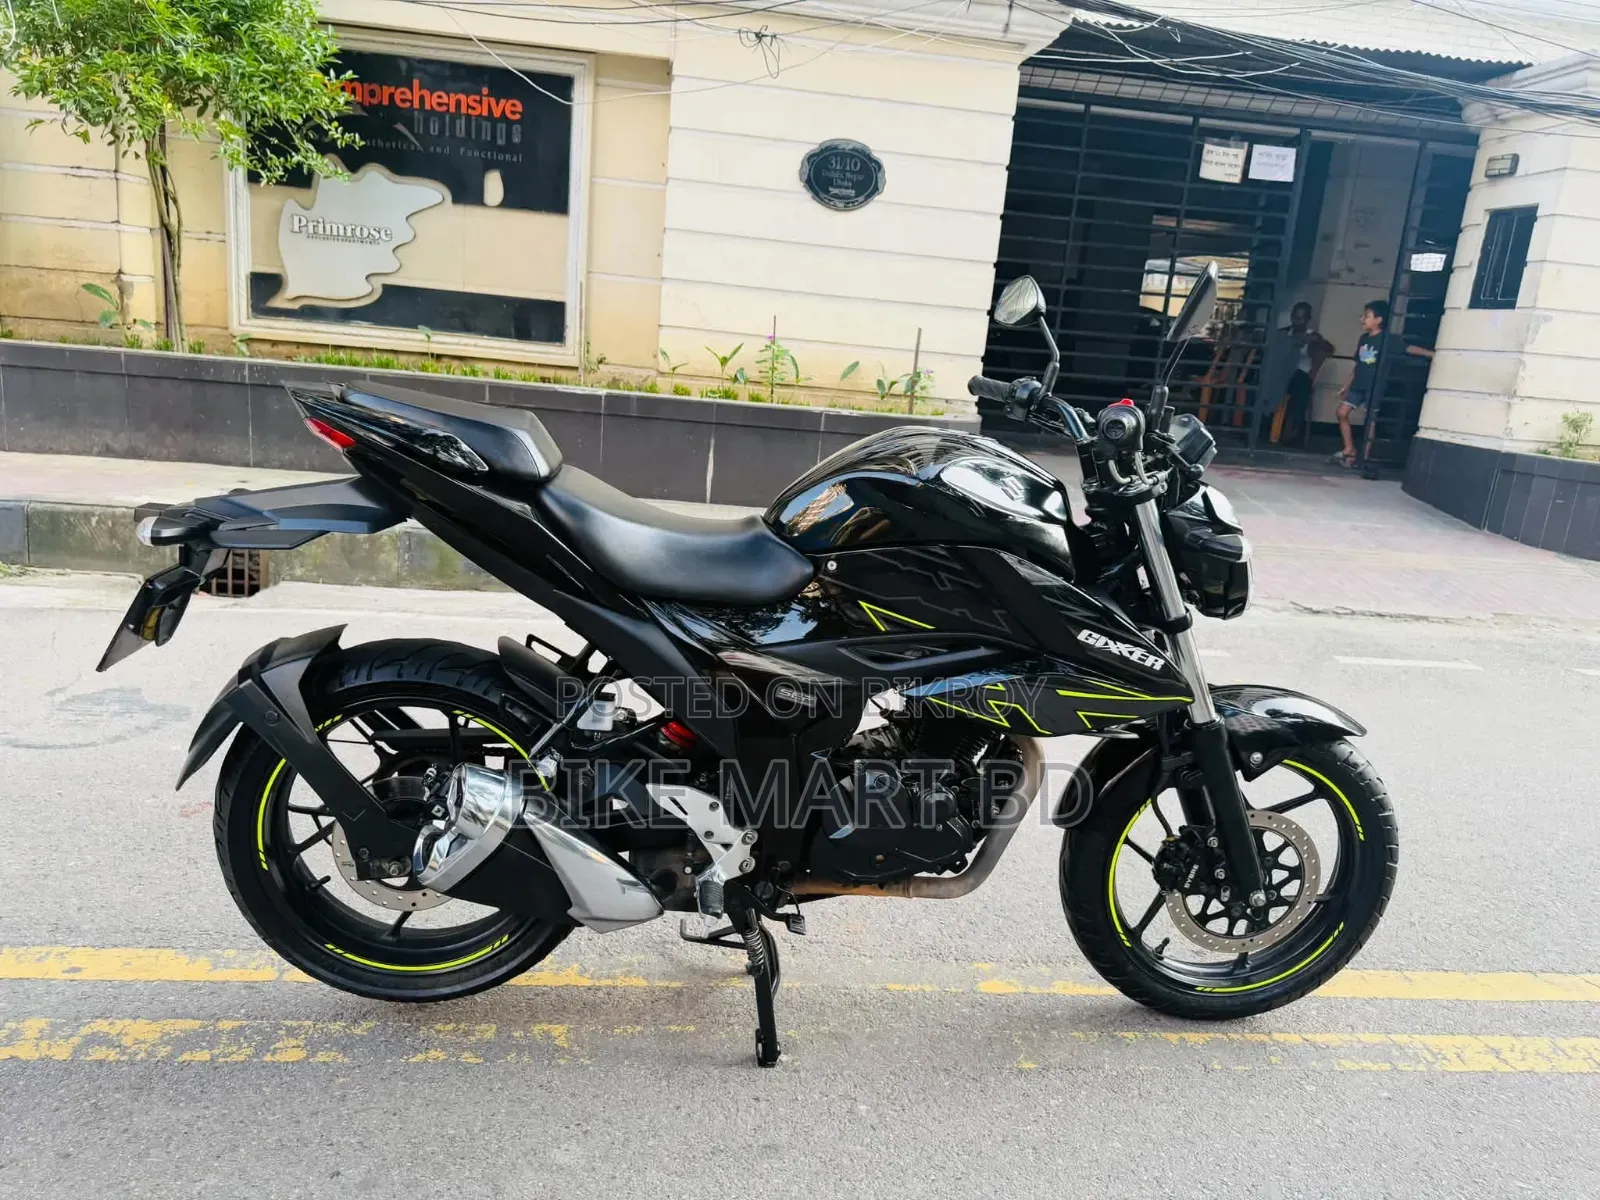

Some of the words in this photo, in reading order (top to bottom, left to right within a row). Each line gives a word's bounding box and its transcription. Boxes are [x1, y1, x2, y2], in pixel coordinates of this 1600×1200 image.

[340, 78, 524, 121] mprehensive
[413, 111, 522, 146] holdings
[459, 147, 523, 163] Functional
[827, 155, 861, 171] 31/10
[290, 214, 393, 242] Primrose
